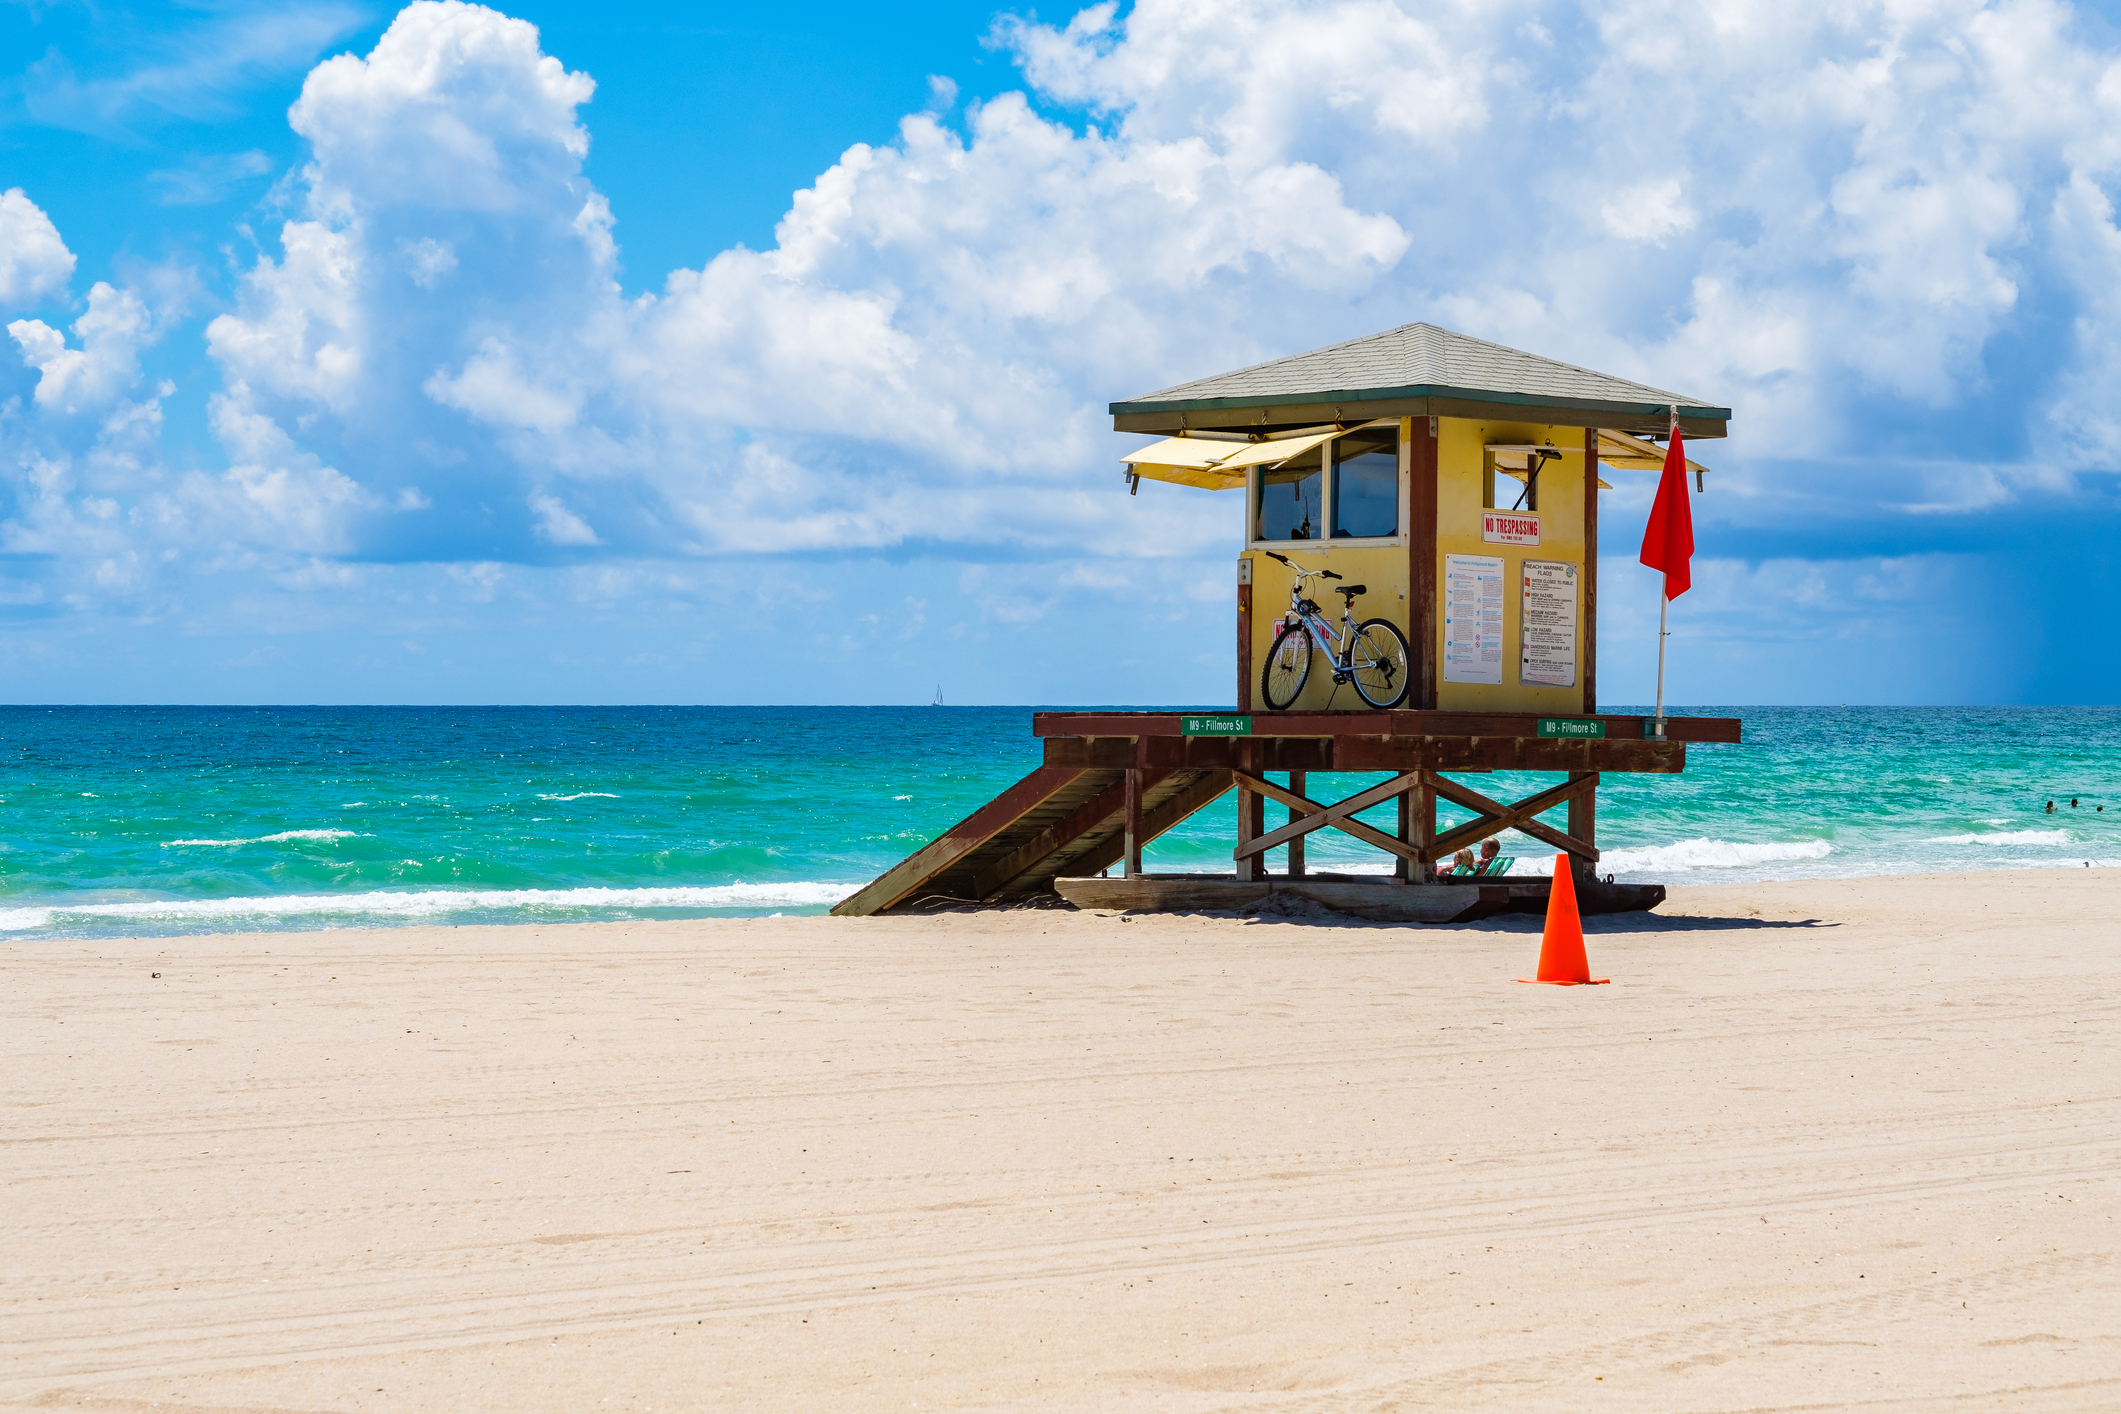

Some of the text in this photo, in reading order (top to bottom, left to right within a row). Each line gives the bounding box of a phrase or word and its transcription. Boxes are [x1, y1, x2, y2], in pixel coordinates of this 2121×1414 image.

[1486, 518, 1538, 536] NO TRESPASSING
[1190, 720, 1199, 730] M9
[1206, 720, 1233, 730] Fillmore
[1236, 720, 1243, 730] St
[1546, 722, 1556, 732] M9
[1562, 722, 1588, 733] Fillmore
[1590, 722, 1597, 733] St
